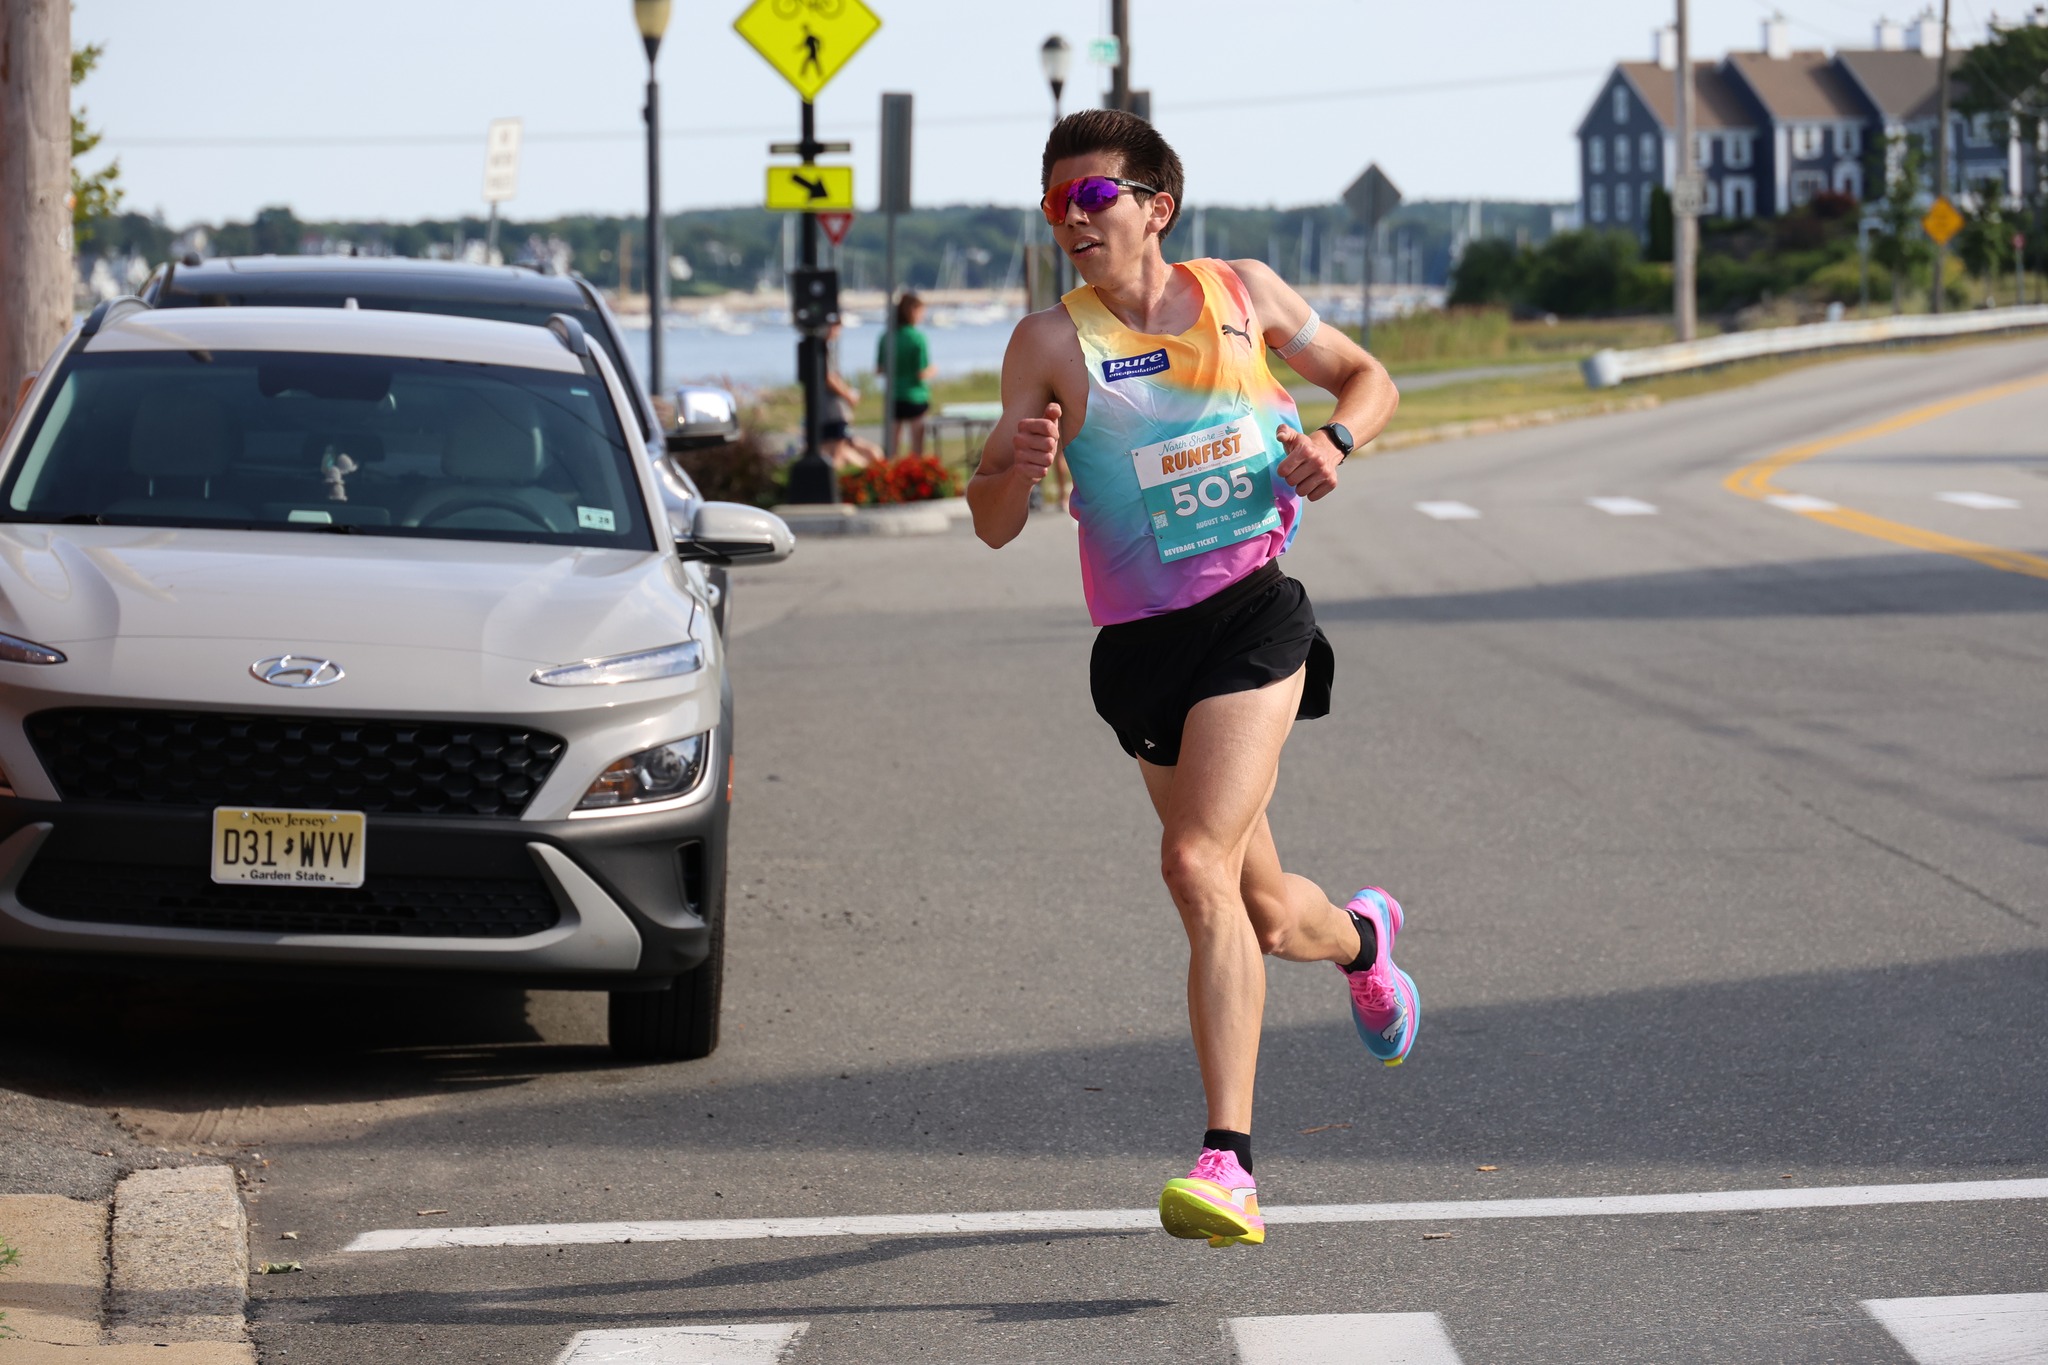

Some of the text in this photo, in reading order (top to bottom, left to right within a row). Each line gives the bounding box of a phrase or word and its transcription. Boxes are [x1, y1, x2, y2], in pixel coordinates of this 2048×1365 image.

[1109, 353, 1163, 373] pure
[1109, 364, 1164, 378] encapsulations
[1159, 432, 1216, 456] North Shore
[1161, 433, 1242, 475] RUNFEST
[1171, 465, 1254, 517] 505
[1196, 519, 1218, 529] AUGUST
[1234, 516, 1277, 536] BEVERAGE TICKET
[1164, 536, 1218, 556] BEVERAGE TICKET
[251, 812, 328, 828] New Jersey
[223, 828, 354, 869] D31 WVV
[249, 869, 326, 882] Garden State
